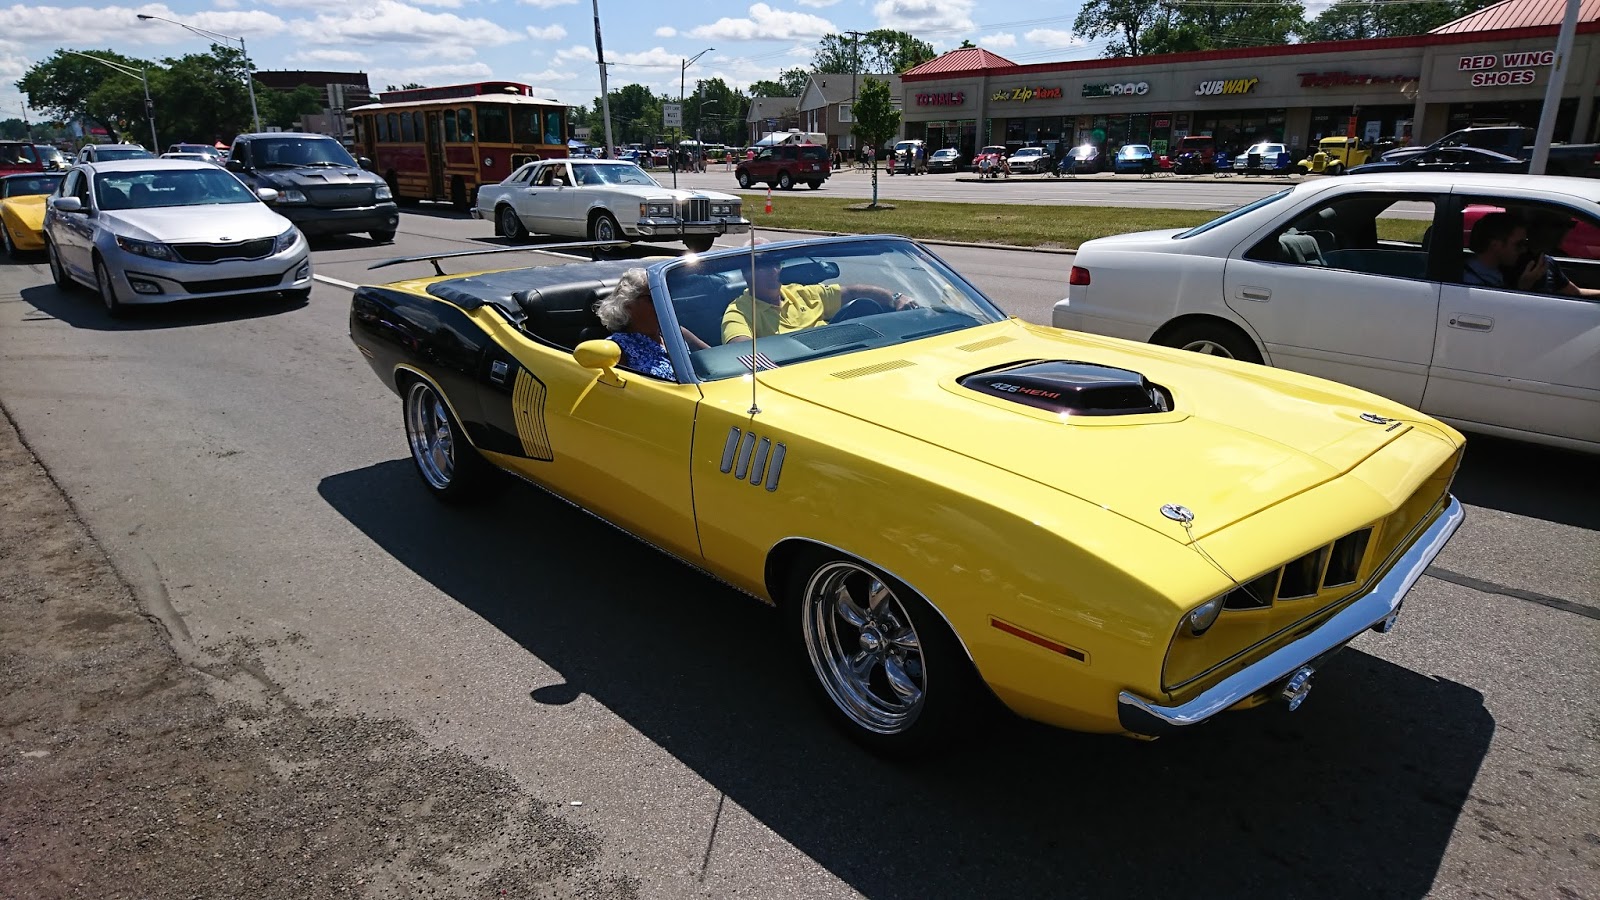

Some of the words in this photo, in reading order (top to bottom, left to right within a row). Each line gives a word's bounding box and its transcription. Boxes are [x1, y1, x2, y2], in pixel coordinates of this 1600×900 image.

[1458, 54, 1497, 71] RED
[1503, 50, 1555, 68] WING
[1195, 78, 1258, 96] SUBWAY
[1471, 69, 1535, 87] SHOES
[932, 91, 964, 106] NAILS
[990, 382, 1020, 393] 426
[1018, 387, 1061, 399] HEMI
